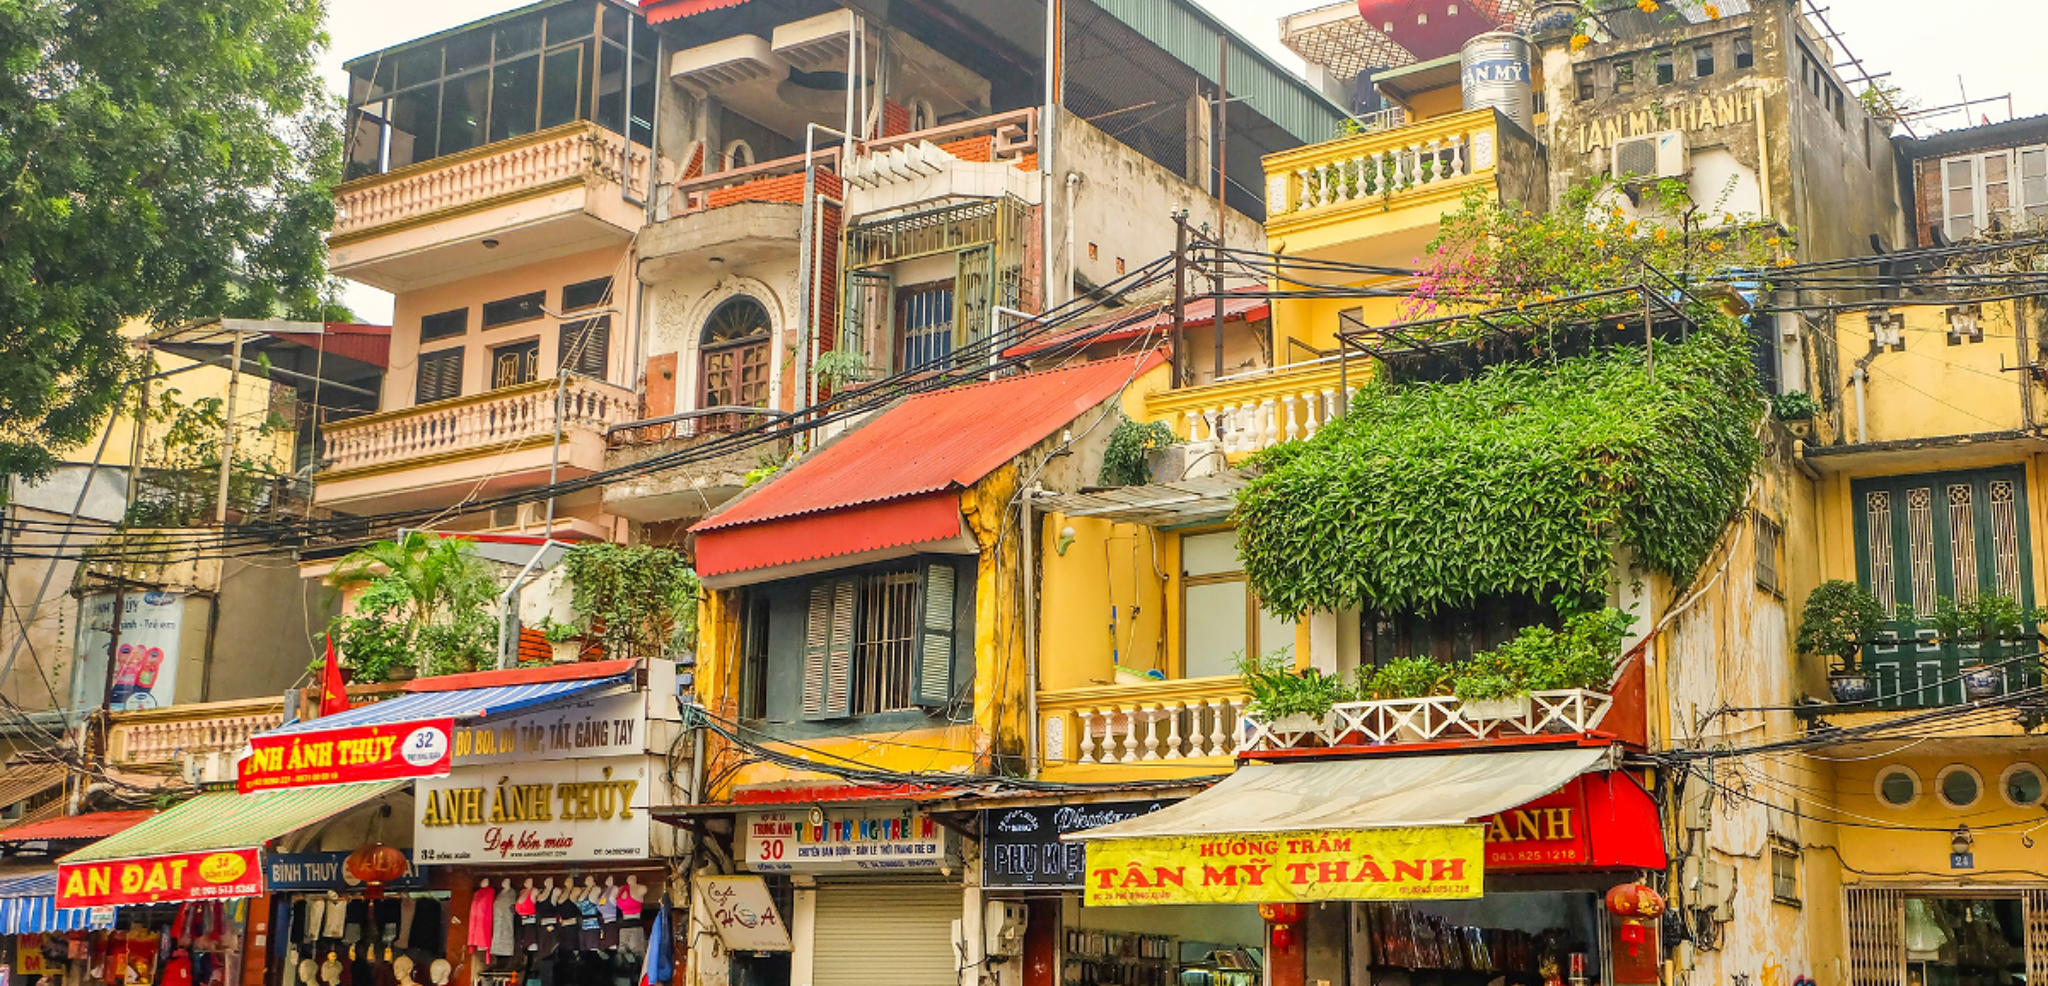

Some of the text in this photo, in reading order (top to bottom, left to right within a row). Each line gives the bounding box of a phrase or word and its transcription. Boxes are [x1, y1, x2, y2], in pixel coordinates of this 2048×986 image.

[416, 731, 434, 748] 32
[575, 716, 608, 748] GĂNG
[614, 718, 635, 746] TAY
[287, 738, 333, 770] ÁNH
[338, 727, 397, 765] THỦY
[422, 766, 638, 826] ANH ÁNH THỦY
[517, 830, 541, 850] bốn
[544, 832, 574, 849] mùa
[753, 822, 793, 835] TRUNG ANH
[833, 818, 878, 842] TRANG
[913, 816, 935, 839] EM
[421, 849, 435, 860] 32
[760, 839, 784, 860] 30
[1199, 838, 1279, 857] HƯƠNG
[216, 857, 229, 869] 34
[271, 859, 301, 882] BÌNH
[994, 843, 1038, 881] PHỤ
[1092, 854, 1467, 889] TÂN MỸ THÀNH
[64, 859, 188, 900] AN ĐẠT
